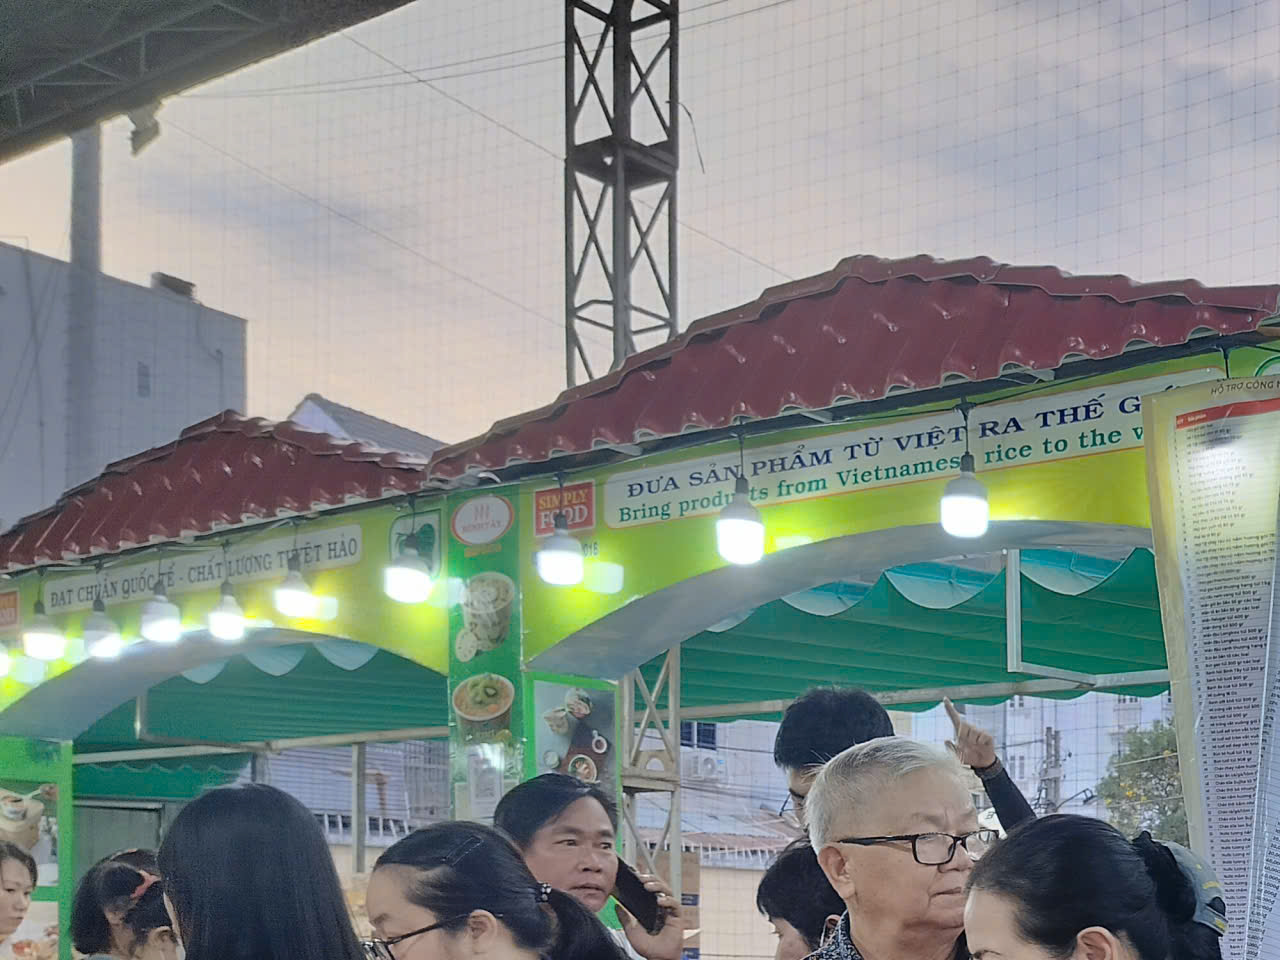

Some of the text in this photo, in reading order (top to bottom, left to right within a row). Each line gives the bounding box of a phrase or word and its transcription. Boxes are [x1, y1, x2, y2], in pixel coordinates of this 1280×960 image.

[619, 505, 671, 522] Bring
[680, 486, 769, 517] produts
[777, 477, 827, 497] from
[837, 454, 962, 487] Vietnames
[985, 444, 1032, 464] rice
[1044, 437, 1068, 454] to
[1079, 428, 1122, 449] the
[628, 475, 680, 498] ĐƯA
[689, 463, 742, 487] SẢN
[752, 445, 832, 477] PHẨM
[844, 437, 883, 460] TỪ
[894, 425, 967, 451] VIỆT
[979, 417, 1024, 438] RA
[1035, 394, 1105, 428] THẾ
[50, 591, 72, 607] ĐẠT
[188, 556, 223, 584] CHẤT
